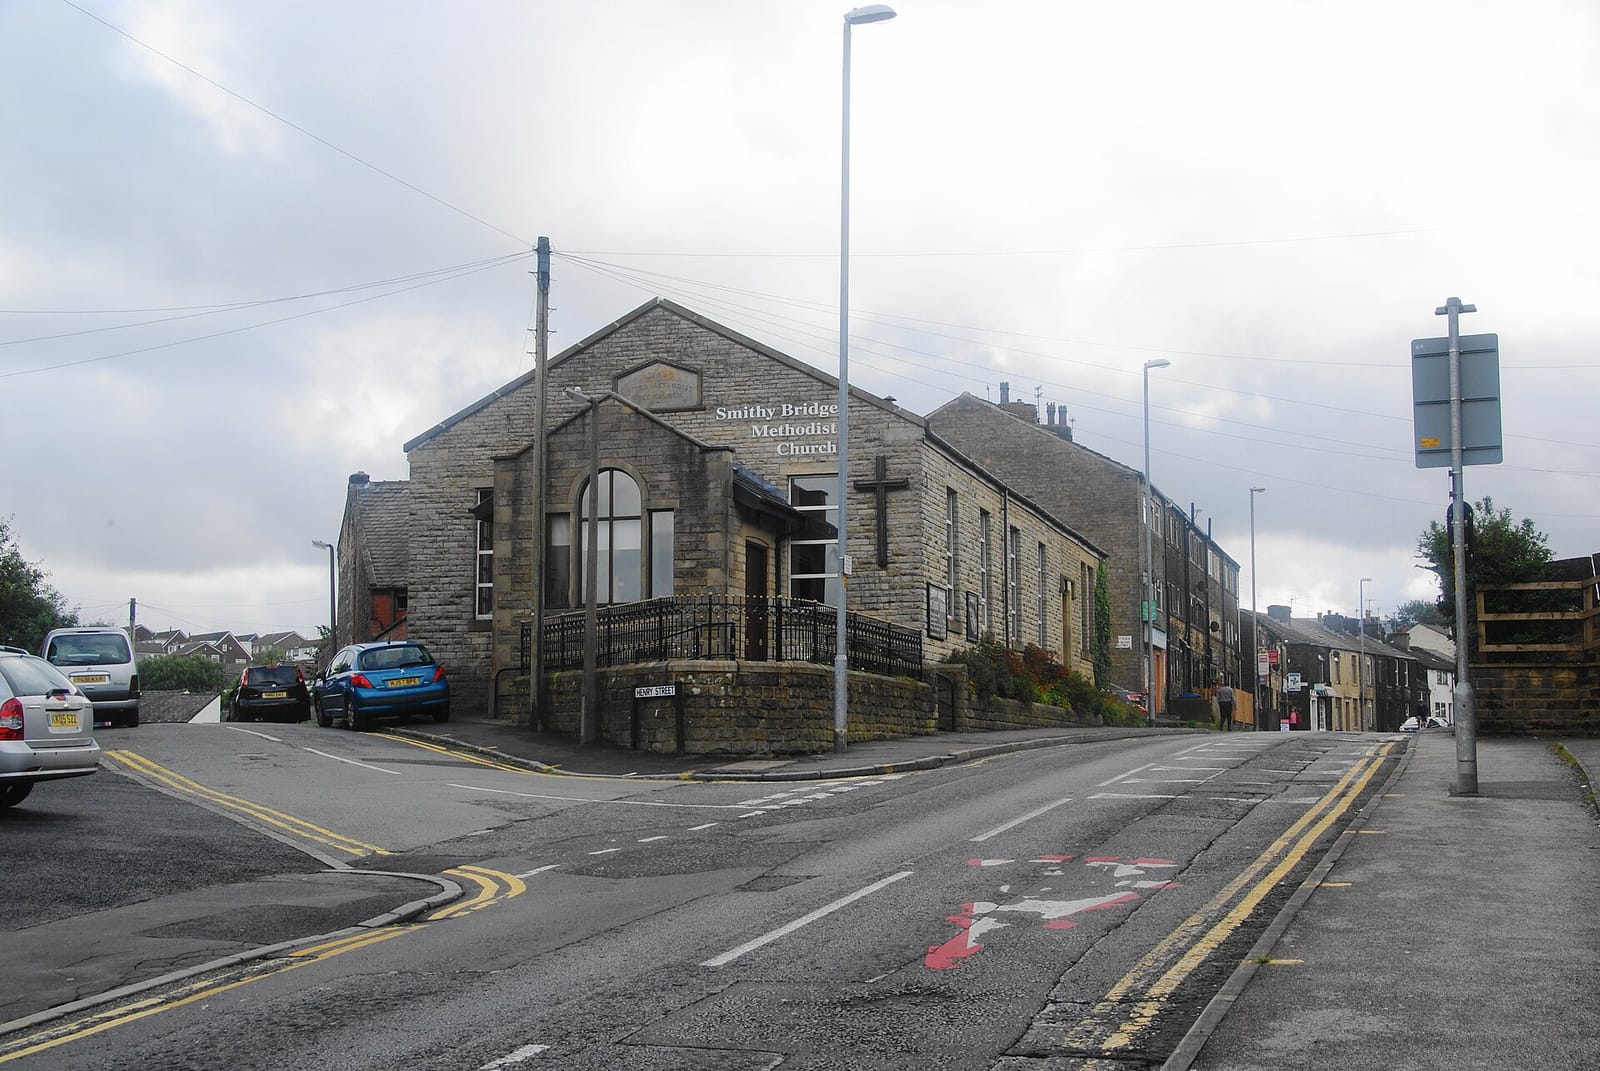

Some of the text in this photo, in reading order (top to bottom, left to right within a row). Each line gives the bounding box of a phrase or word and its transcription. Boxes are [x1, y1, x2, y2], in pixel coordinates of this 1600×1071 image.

[716, 402, 839, 420] Smithy Bridge
[752, 422, 837, 437] Methodist
[776, 441, 837, 455] Church
[636, 686, 674, 697] HENRY STREET
